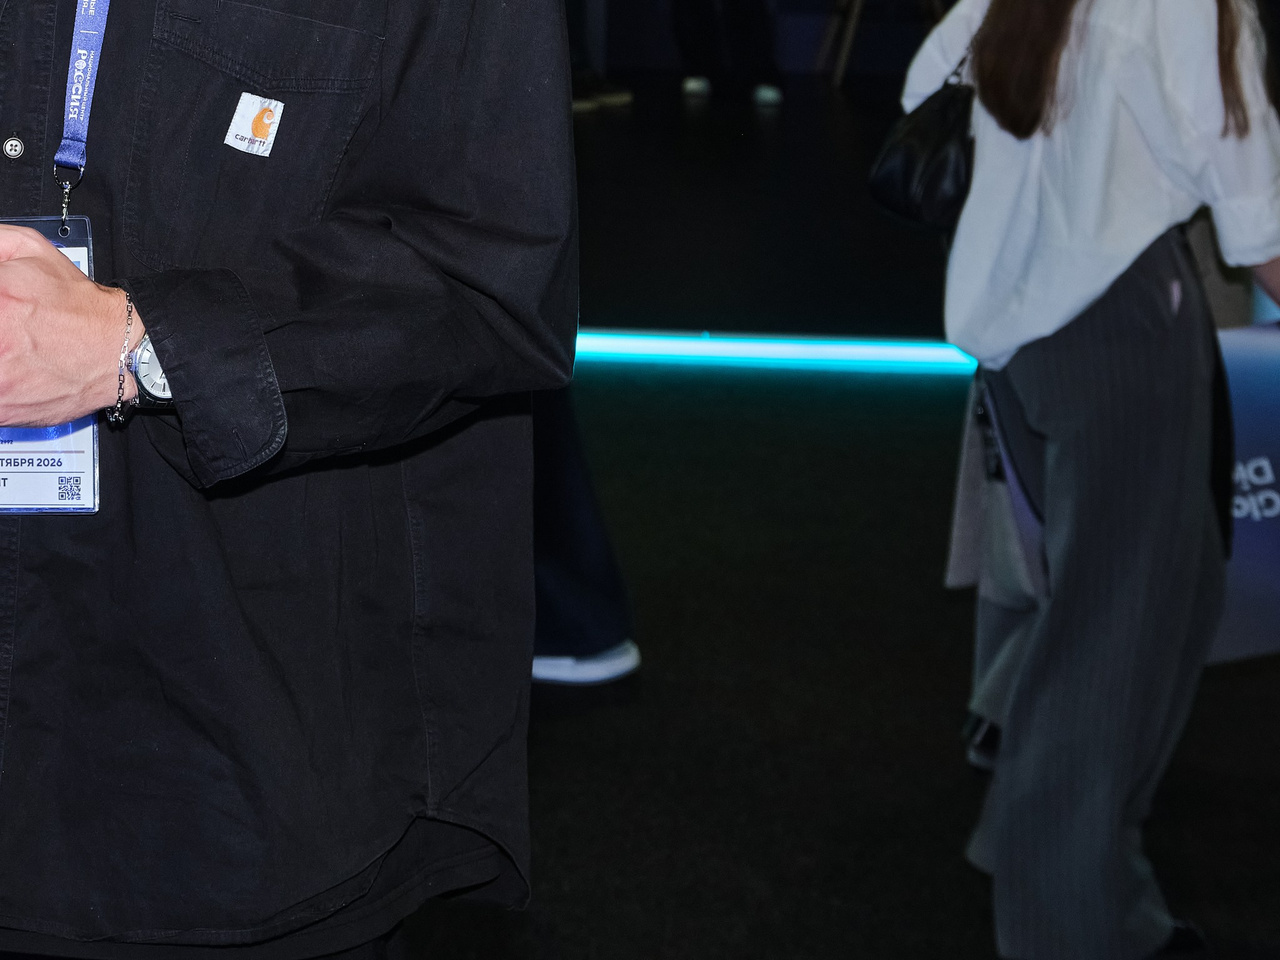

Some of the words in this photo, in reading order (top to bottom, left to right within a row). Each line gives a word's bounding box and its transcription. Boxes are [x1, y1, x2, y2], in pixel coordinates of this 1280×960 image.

[68, 47, 89, 121] РОССИЯ
[234, 133, 266, 147] carhartt
[36, 458, 63, 467] 2026
